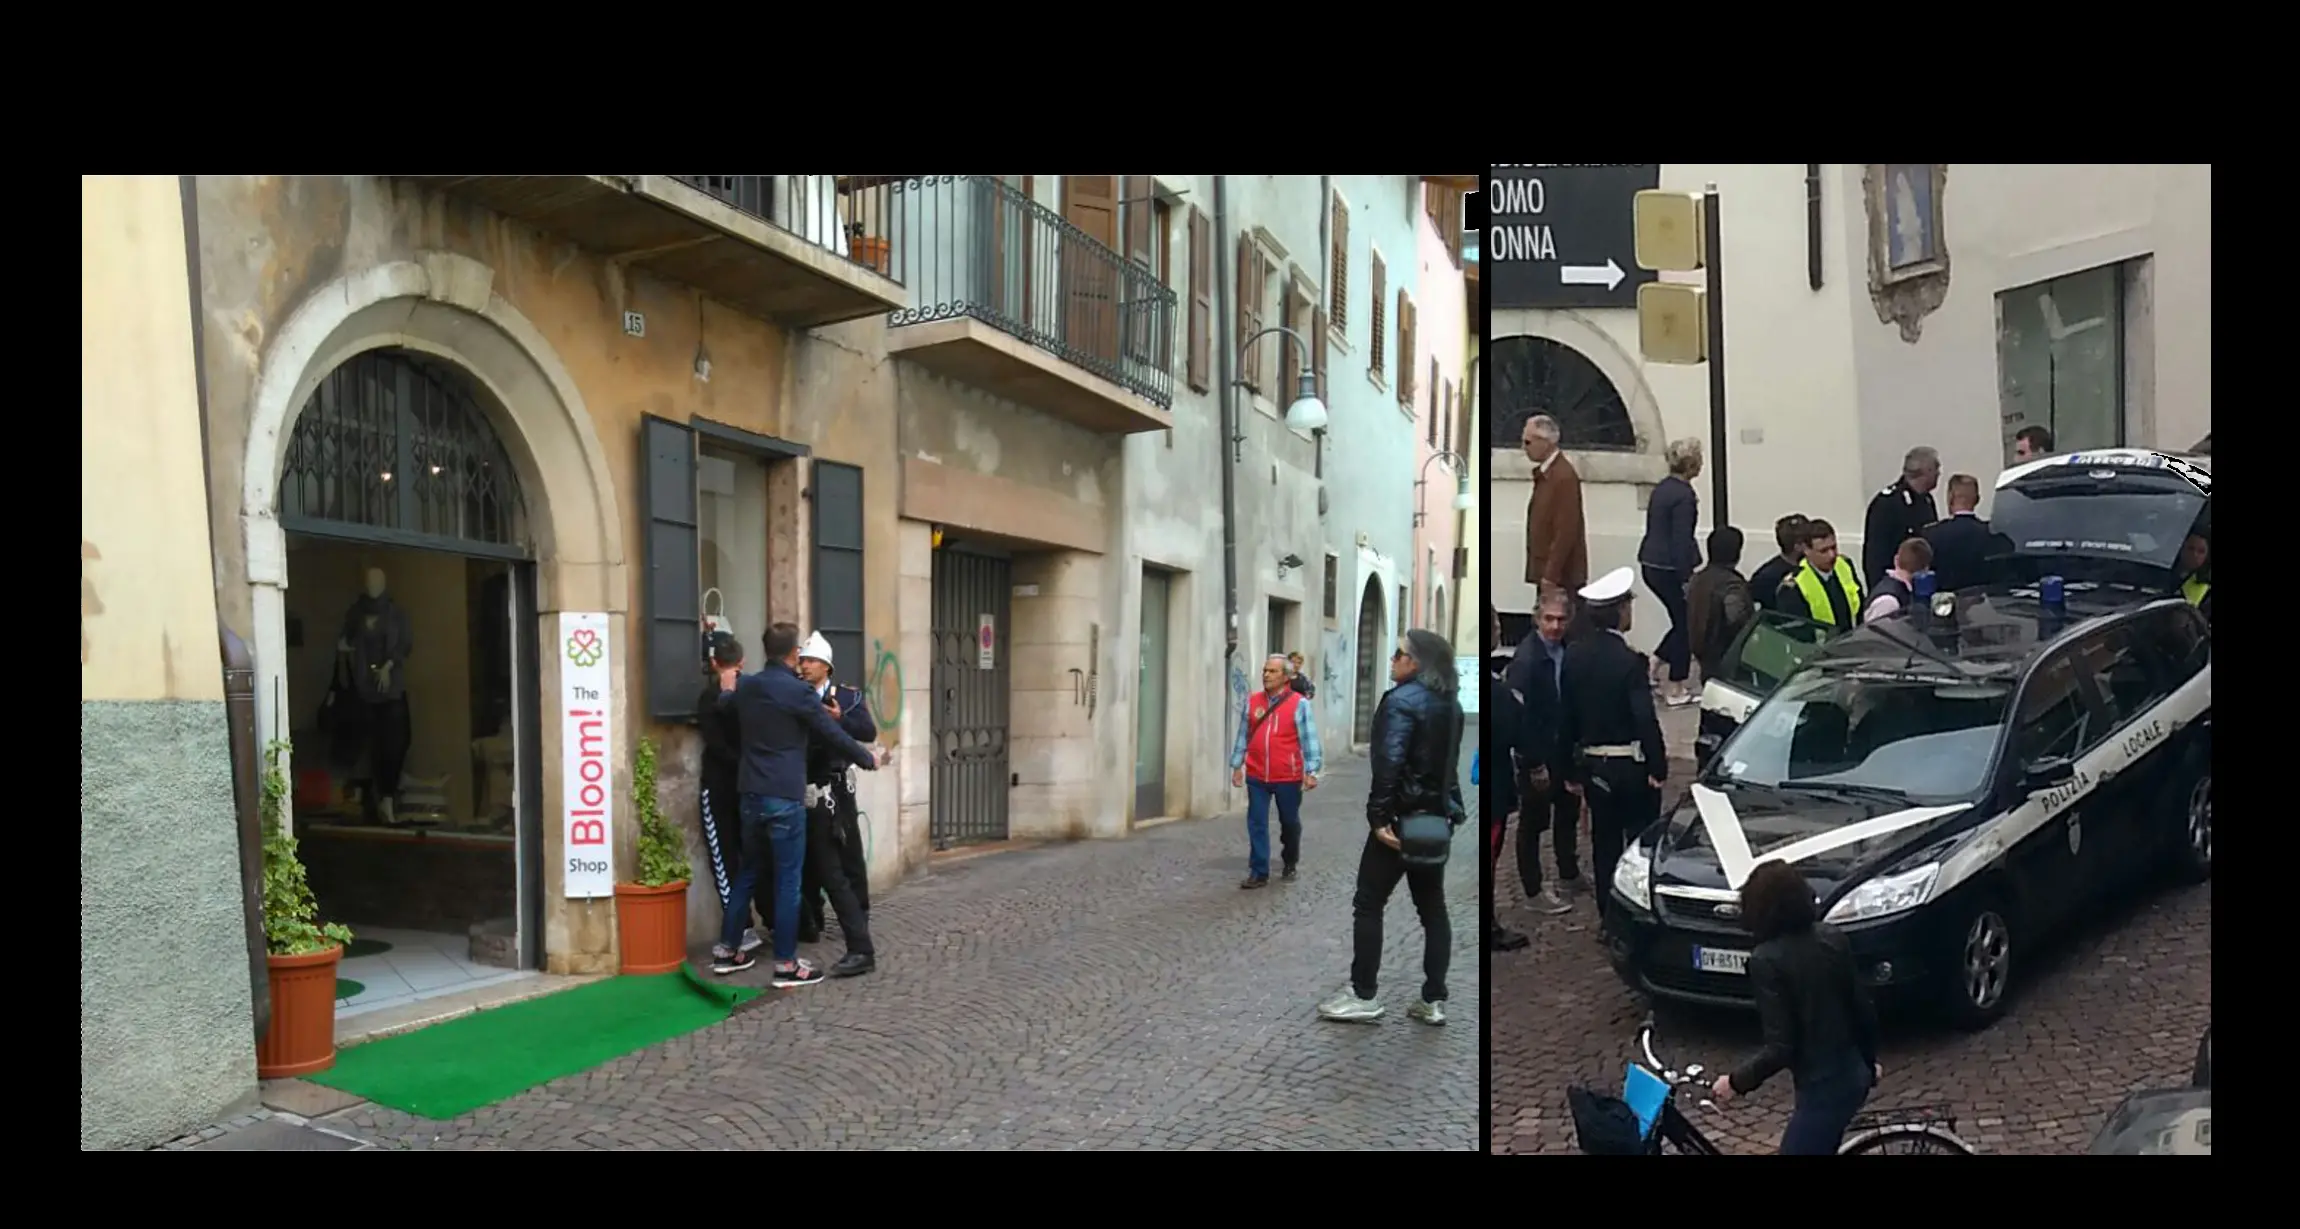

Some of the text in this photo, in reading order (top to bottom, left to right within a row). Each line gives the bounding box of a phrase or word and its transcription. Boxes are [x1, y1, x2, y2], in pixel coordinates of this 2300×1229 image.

[1491, 178, 1545, 214] OMO
[1491, 225, 1557, 261] ONNA
[629, 314, 642, 334] 15
[572, 686, 599, 700] The
[569, 709, 605, 845] Bloom!
[2041, 720, 2164, 813] POLIZIA LOCALE
[569, 858, 608, 873] Shop
